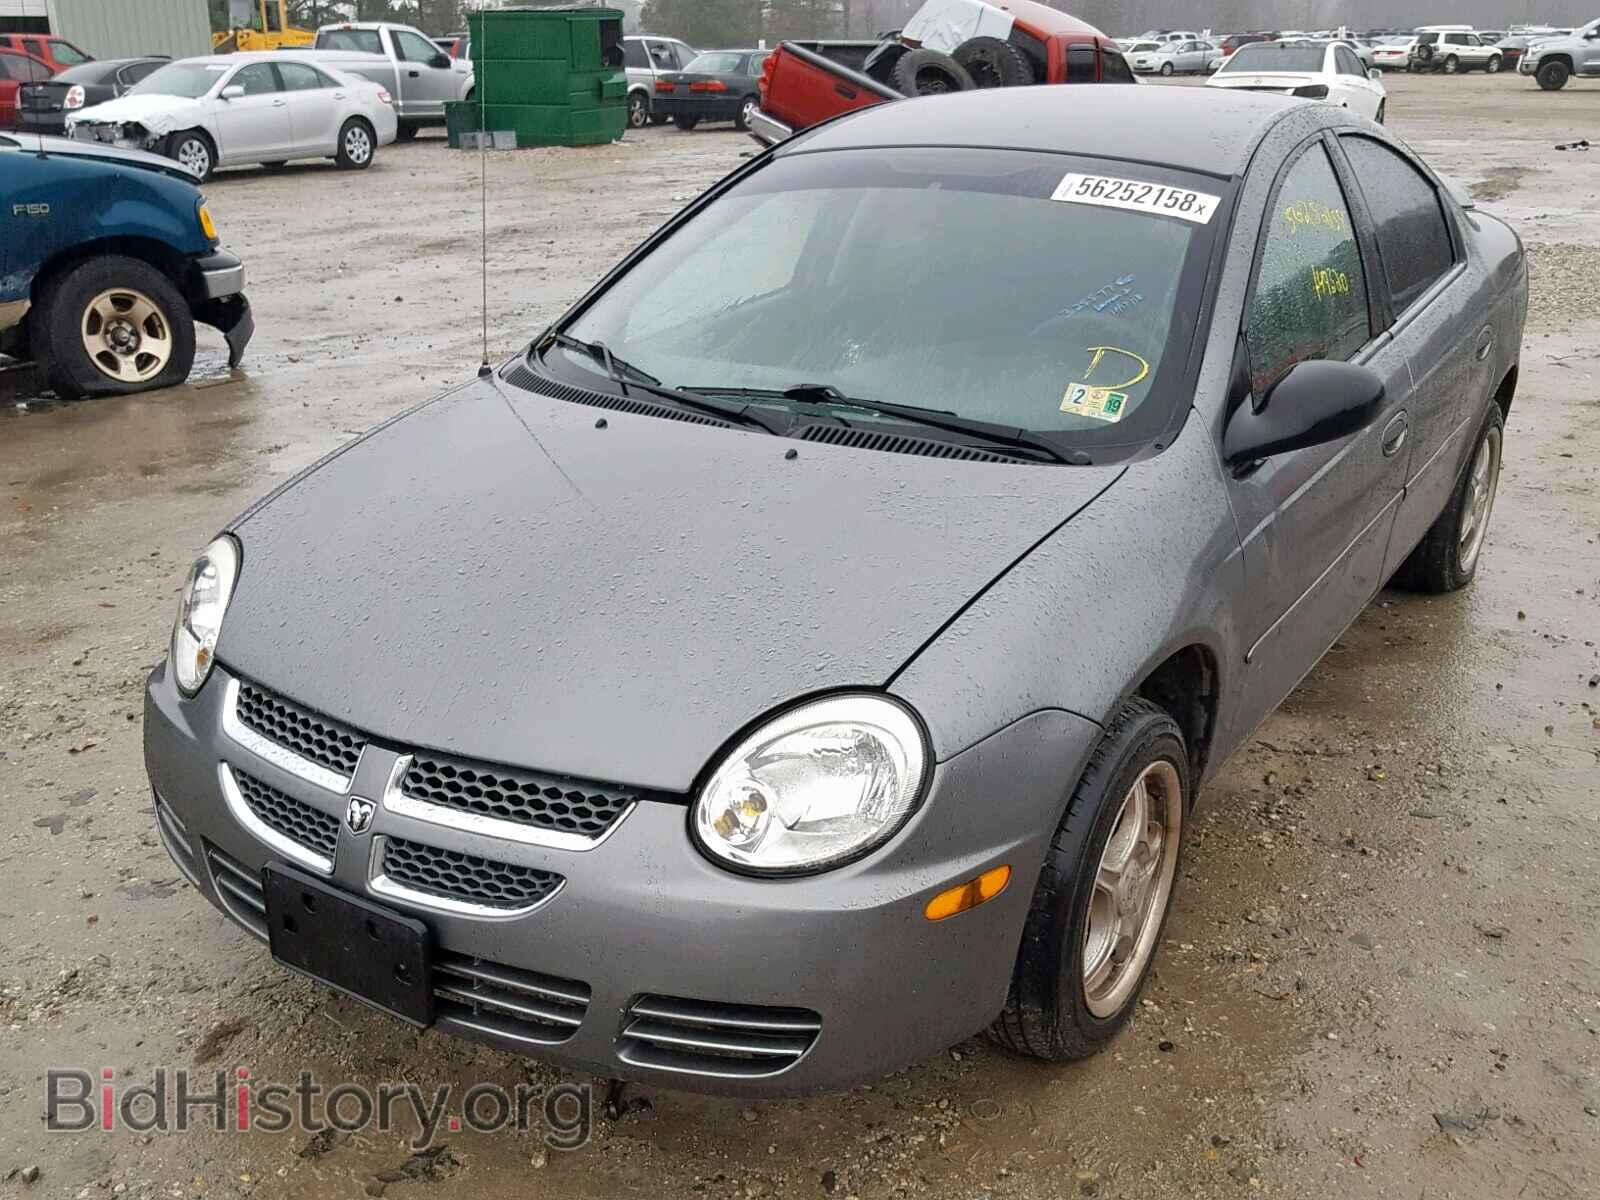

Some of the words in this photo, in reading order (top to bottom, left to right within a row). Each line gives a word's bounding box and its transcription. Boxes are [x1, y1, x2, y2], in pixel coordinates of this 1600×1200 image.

[1083, 345, 1149, 390] D
[1072, 388, 1086, 404] 2
[1106, 398, 1122, 413] 19
